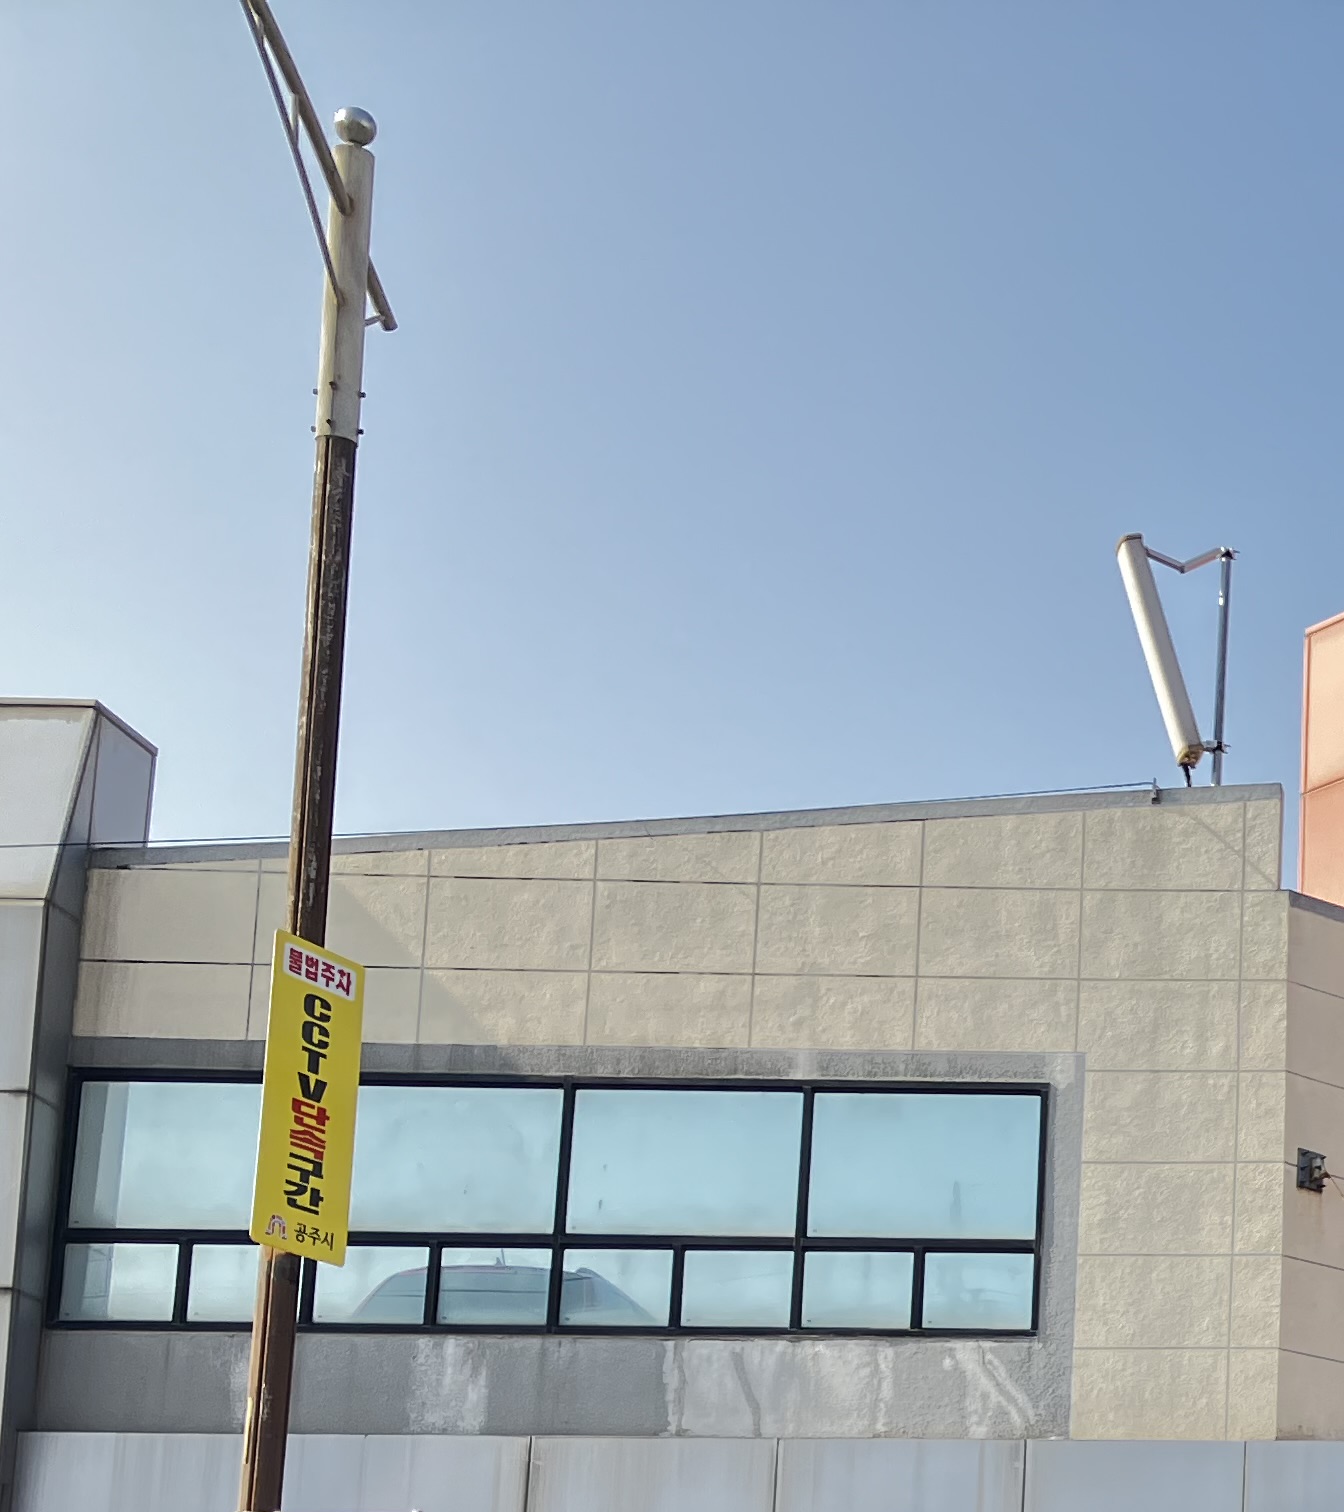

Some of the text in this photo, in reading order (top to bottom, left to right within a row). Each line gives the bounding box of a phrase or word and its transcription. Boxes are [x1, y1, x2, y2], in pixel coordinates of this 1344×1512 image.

[289, 948, 352, 996] 불법주차
[284, 993, 331, 1216] CCTV단속구간
[294, 1222, 334, 1251] 공주시
